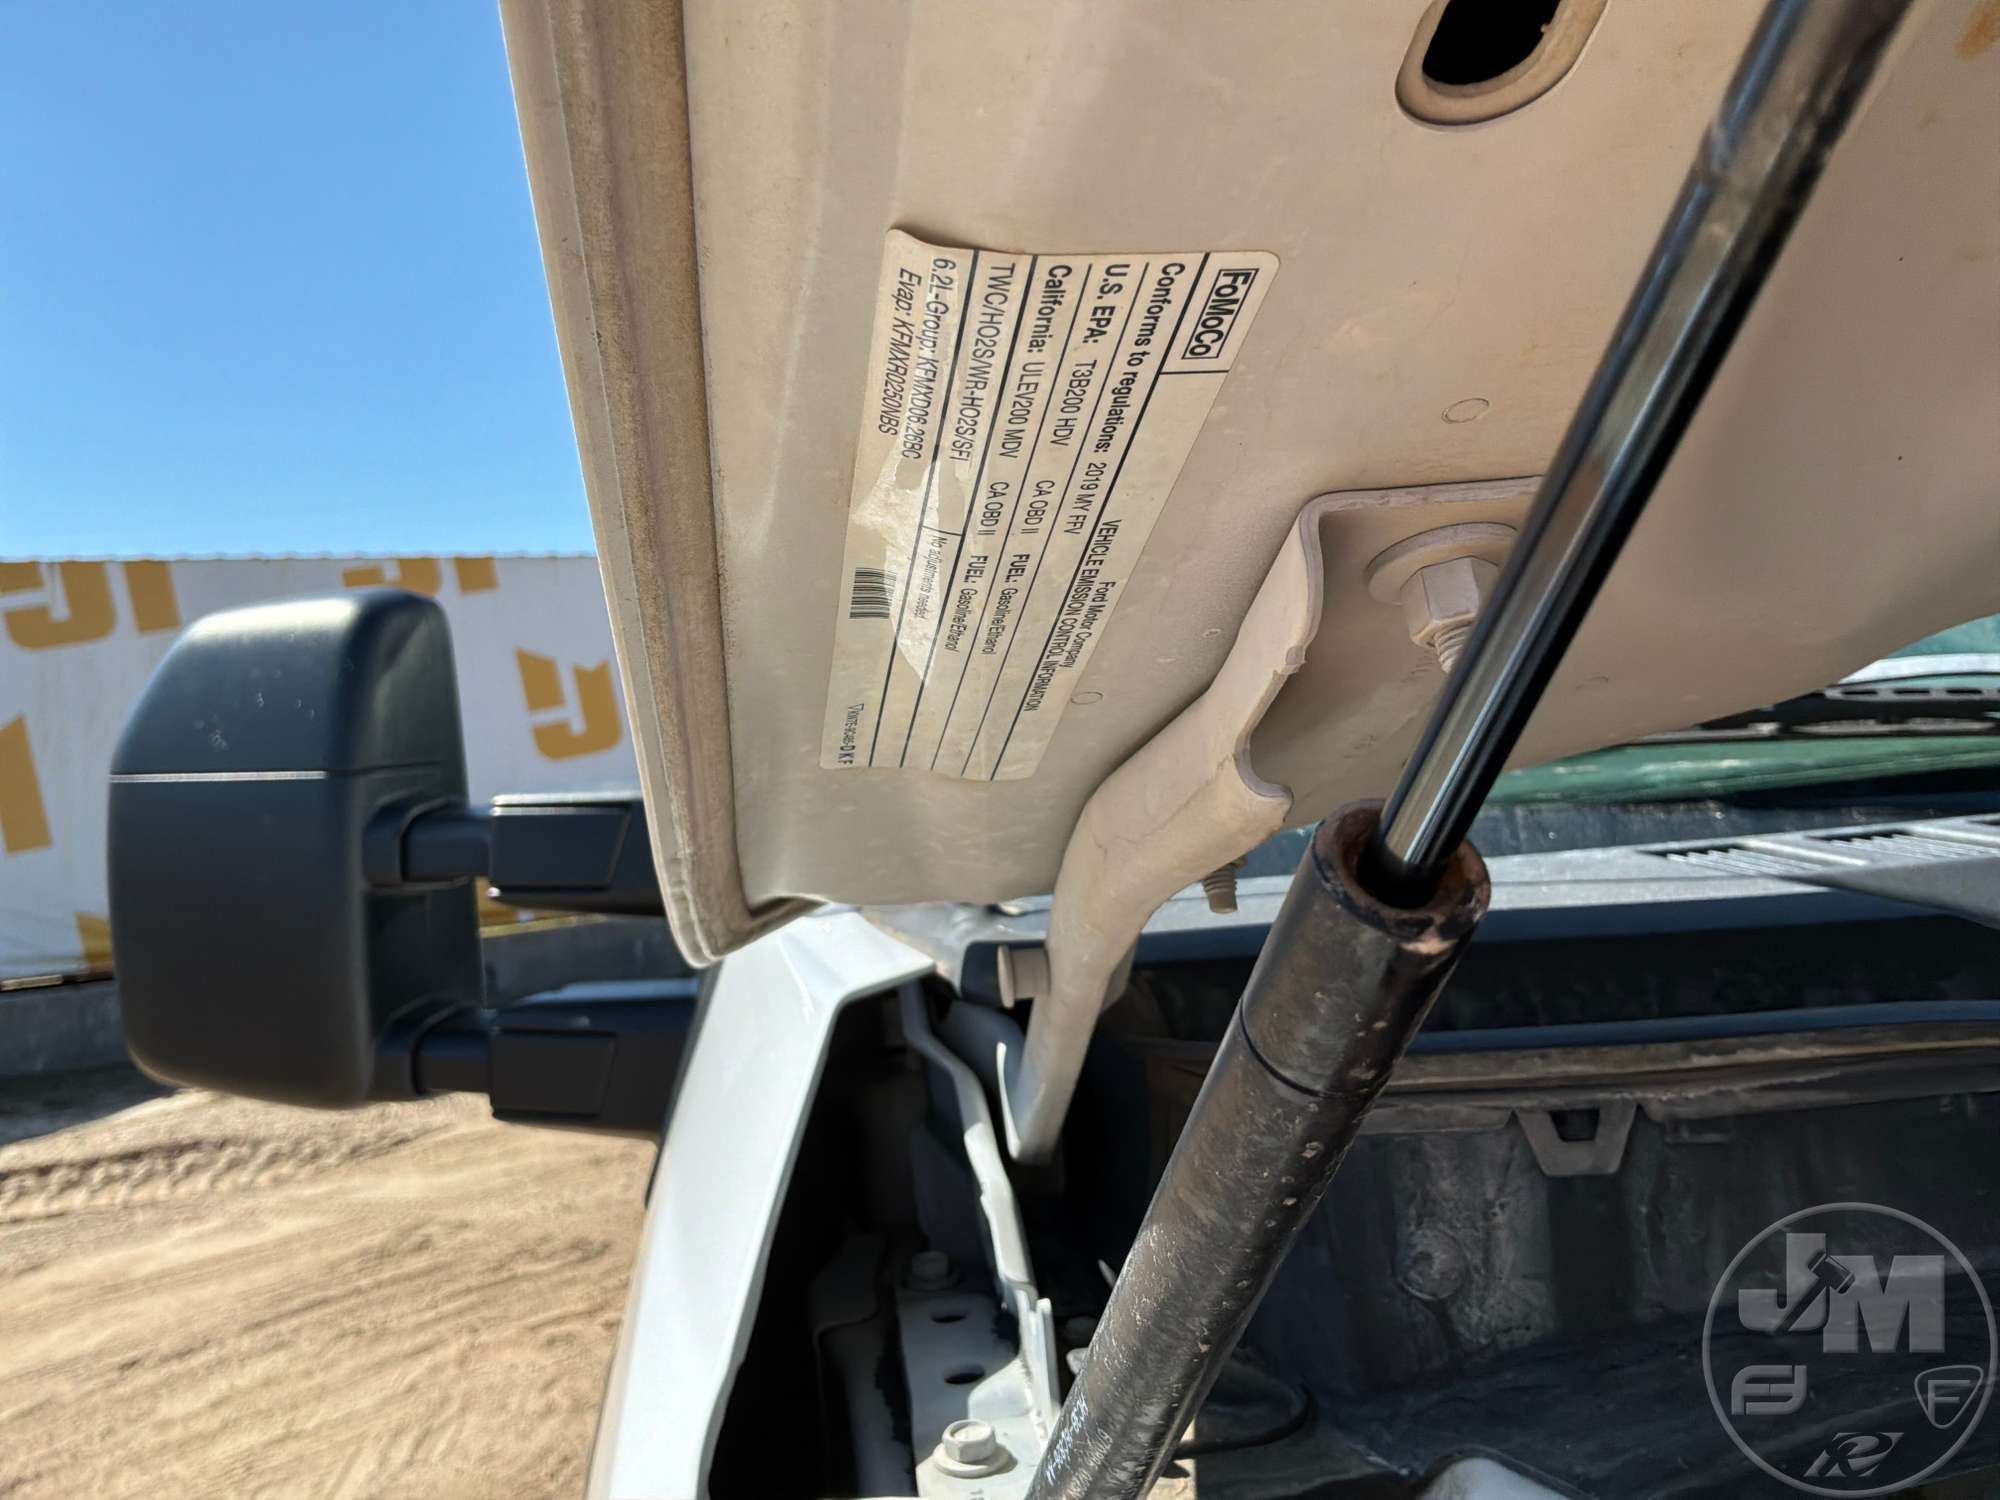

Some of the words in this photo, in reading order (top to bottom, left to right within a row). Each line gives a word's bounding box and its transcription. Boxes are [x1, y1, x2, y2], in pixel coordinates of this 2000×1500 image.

[891, 267, 922, 316] Evap:
[1096, 264, 1131, 300] U.S.
[915, 258, 956, 353] 6.2L-Group:
[1027, 264, 1072, 353] California:
[1134, 262, 1186, 347] Conforms
[1187, 271, 1252, 356] FoMoCo
[1082, 305, 1116, 344] EPA:
[878, 317, 915, 435] KFMXR0250NBS
[949, 262, 1016, 461] TWC/HO2S/WR-HO2S/SFI
[1126, 350, 1151, 367] to
[1008, 362, 1046, 424] ULEV200
[1060, 359, 1097, 413] T3B200
[901, 355, 940, 459] KFMXD06.26BC
[1093, 371, 1139, 453] regulations:
[998, 429, 1026, 458] MDV
[1050, 418, 1078, 446] HDV
[987, 482, 1010, 499] CA
[1032, 480, 1055, 497] CA
[1080, 462, 1107, 490] 2019
[980, 500, 1004, 527] OBD
[1024, 500, 1048, 525] OBD
[1072, 494, 1096, 511] MY
[931, 536, 948, 548] No
[1064, 515, 1087, 534] FFV
[1085, 519, 1122, 566] VEHICLE
[963, 555, 989, 583] FUEL:
[1004, 554, 1031, 583] FUEL:
[1064, 569, 1100, 615] EMISSION
[1092, 582, 1117, 602] Ford
[944, 588, 978, 652] Gasoline/Ethanol
[981, 588, 1018, 655] Gasoline/Ethanol
[1080, 605, 1106, 630] Motor
[1046, 618, 1078, 659] CONTROL
[1059, 632, 1092, 668] Company
[1024, 661, 1059, 711] INFORMATION
